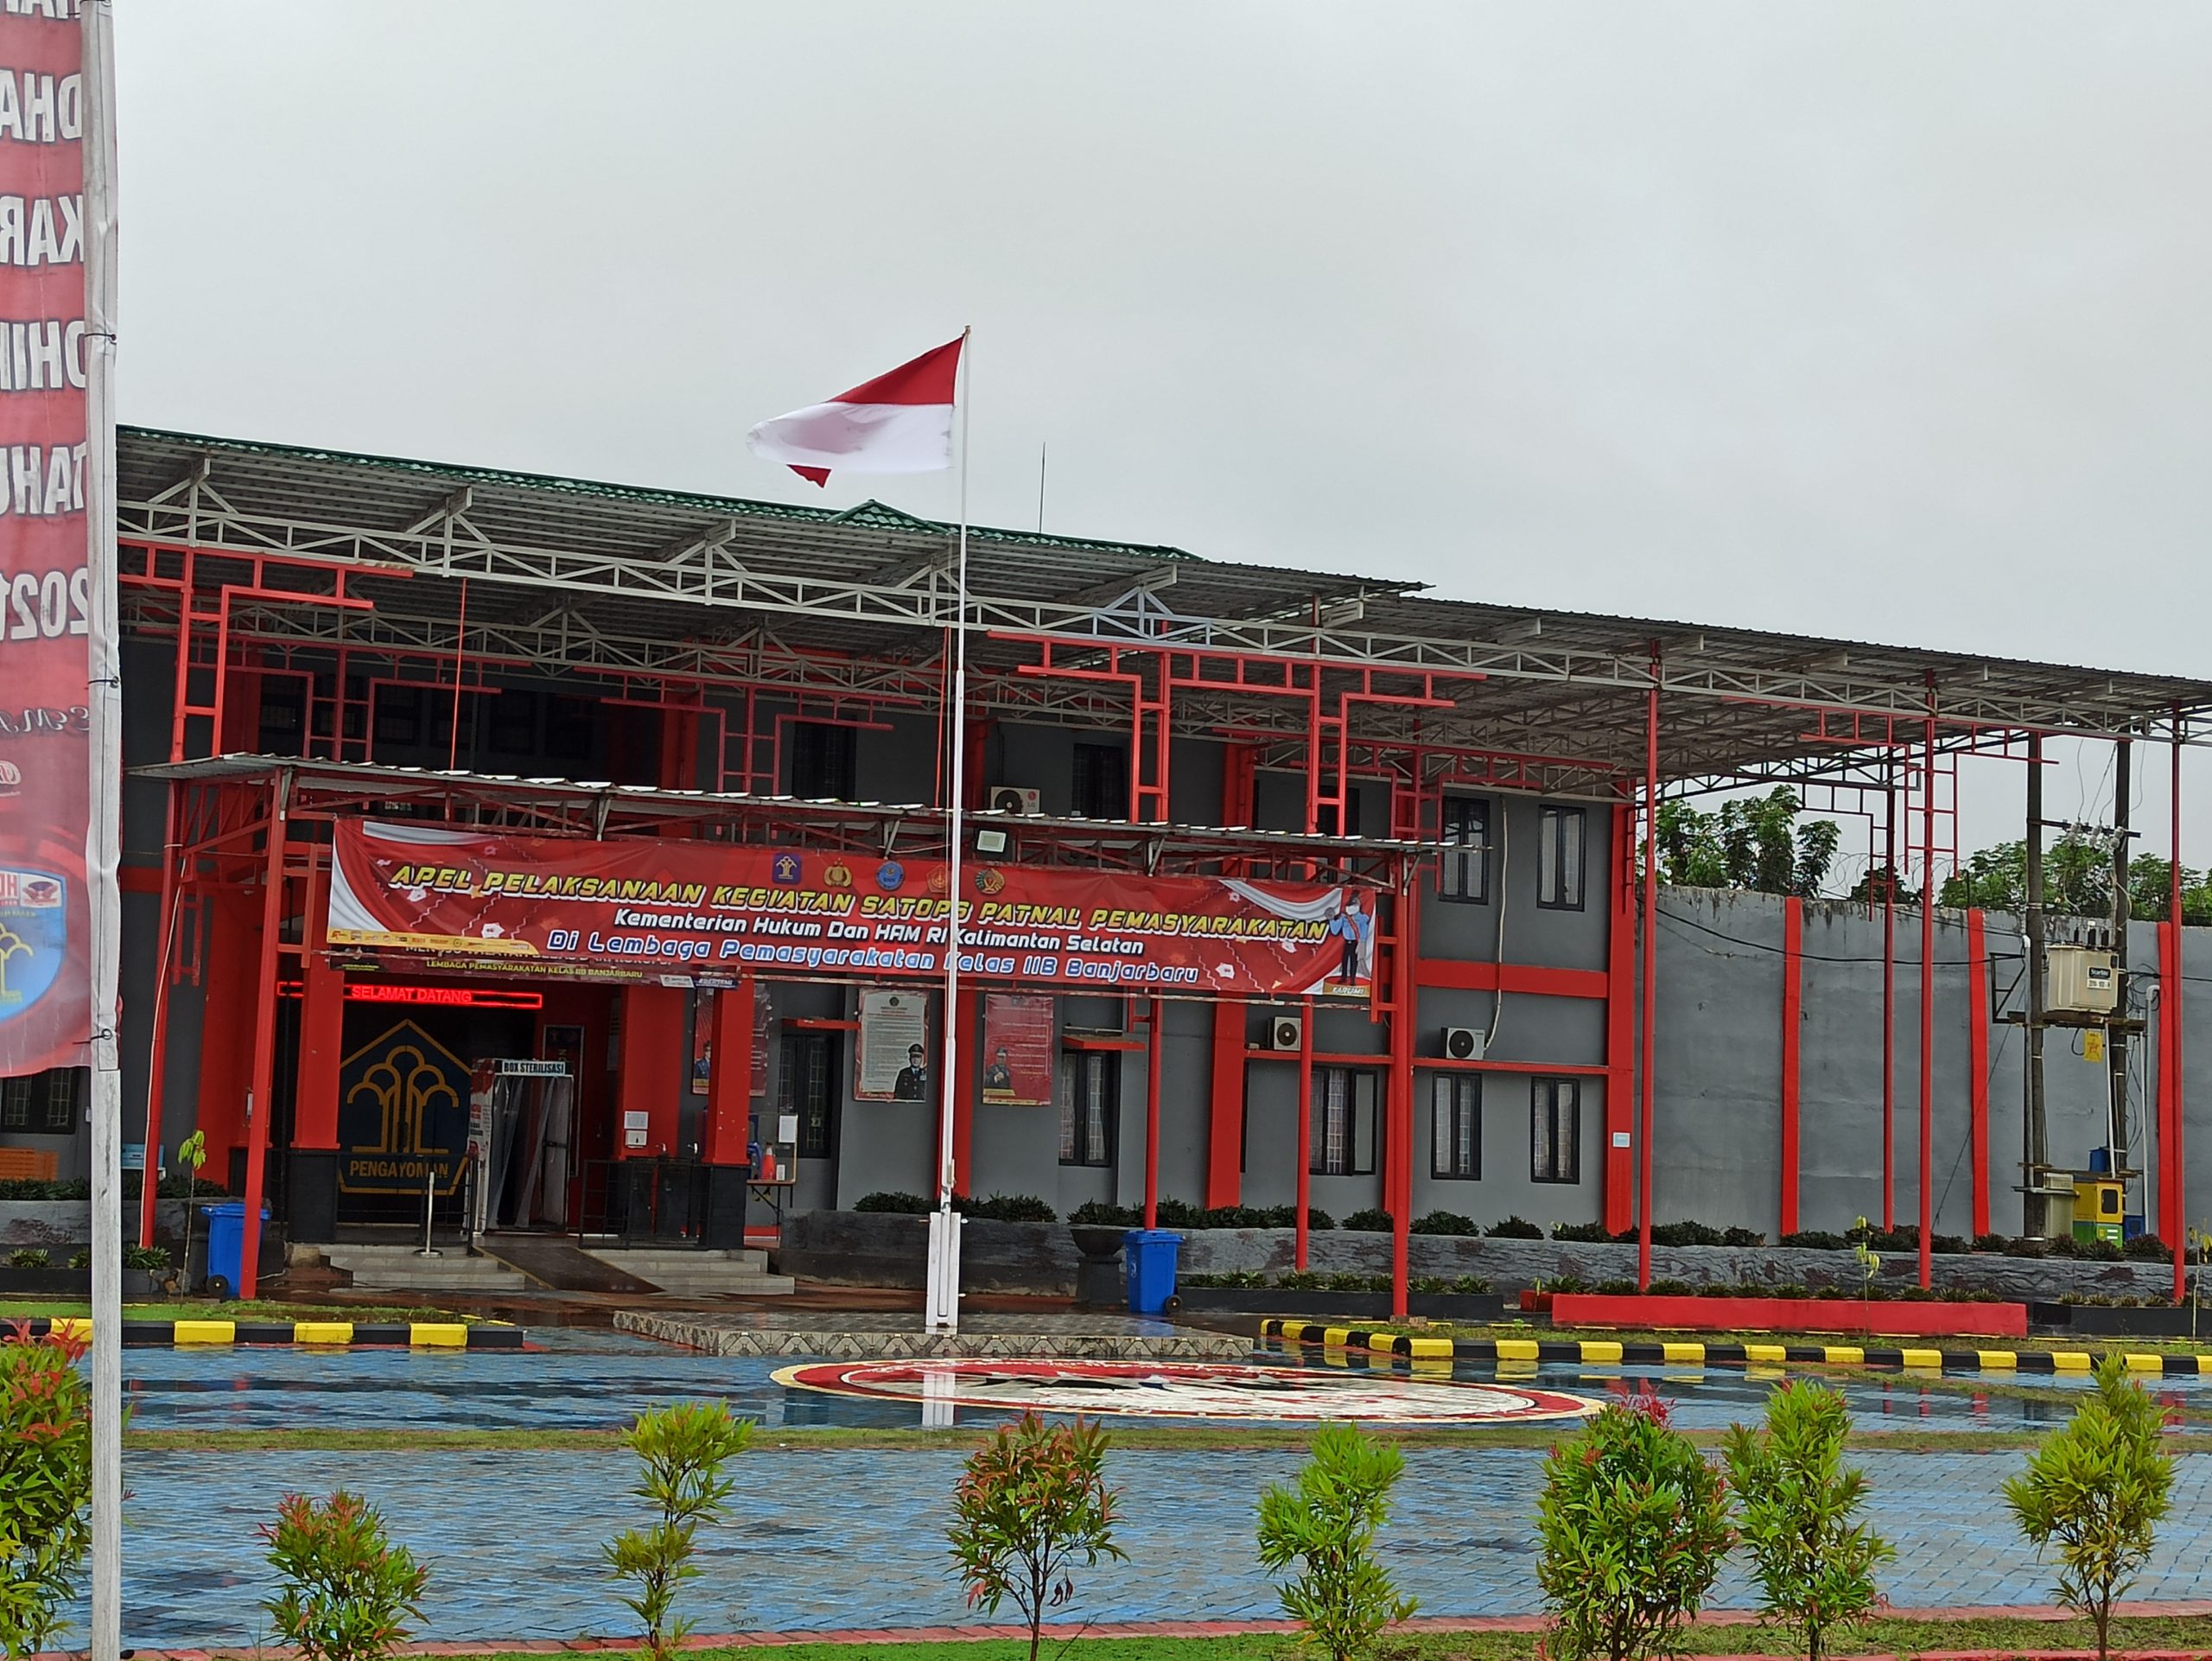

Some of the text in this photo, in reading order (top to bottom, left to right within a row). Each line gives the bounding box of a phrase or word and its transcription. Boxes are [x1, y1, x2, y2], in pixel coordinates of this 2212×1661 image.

[390, 865, 1331, 944] APEL PELAKSANAAN KEGIATAN SATOPS PATNAL PEMASYARAKATAN
[614, 909, 1145, 955] Kementerian Hukum Dan HAM RI Kalimantan Selatan
[427, 960, 467, 969] LEMBAGA
[469, 963, 546, 973] PEMASYARAKATAN
[549, 965, 574, 975] KELAS
[588, 968, 643, 978] BANJARBARU
[547, 929, 579, 951] Di
[588, 932, 711, 961] Lembaga
[720, 939, 935, 970] Pemasyarakatan
[1022, 956, 1058, 977] IIB
[1065, 959, 1199, 983] Banjarbaru
[352, 985, 473, 1003] SELAMAT DATANG
[504, 1062, 564, 1072] BOX STERILISASI
